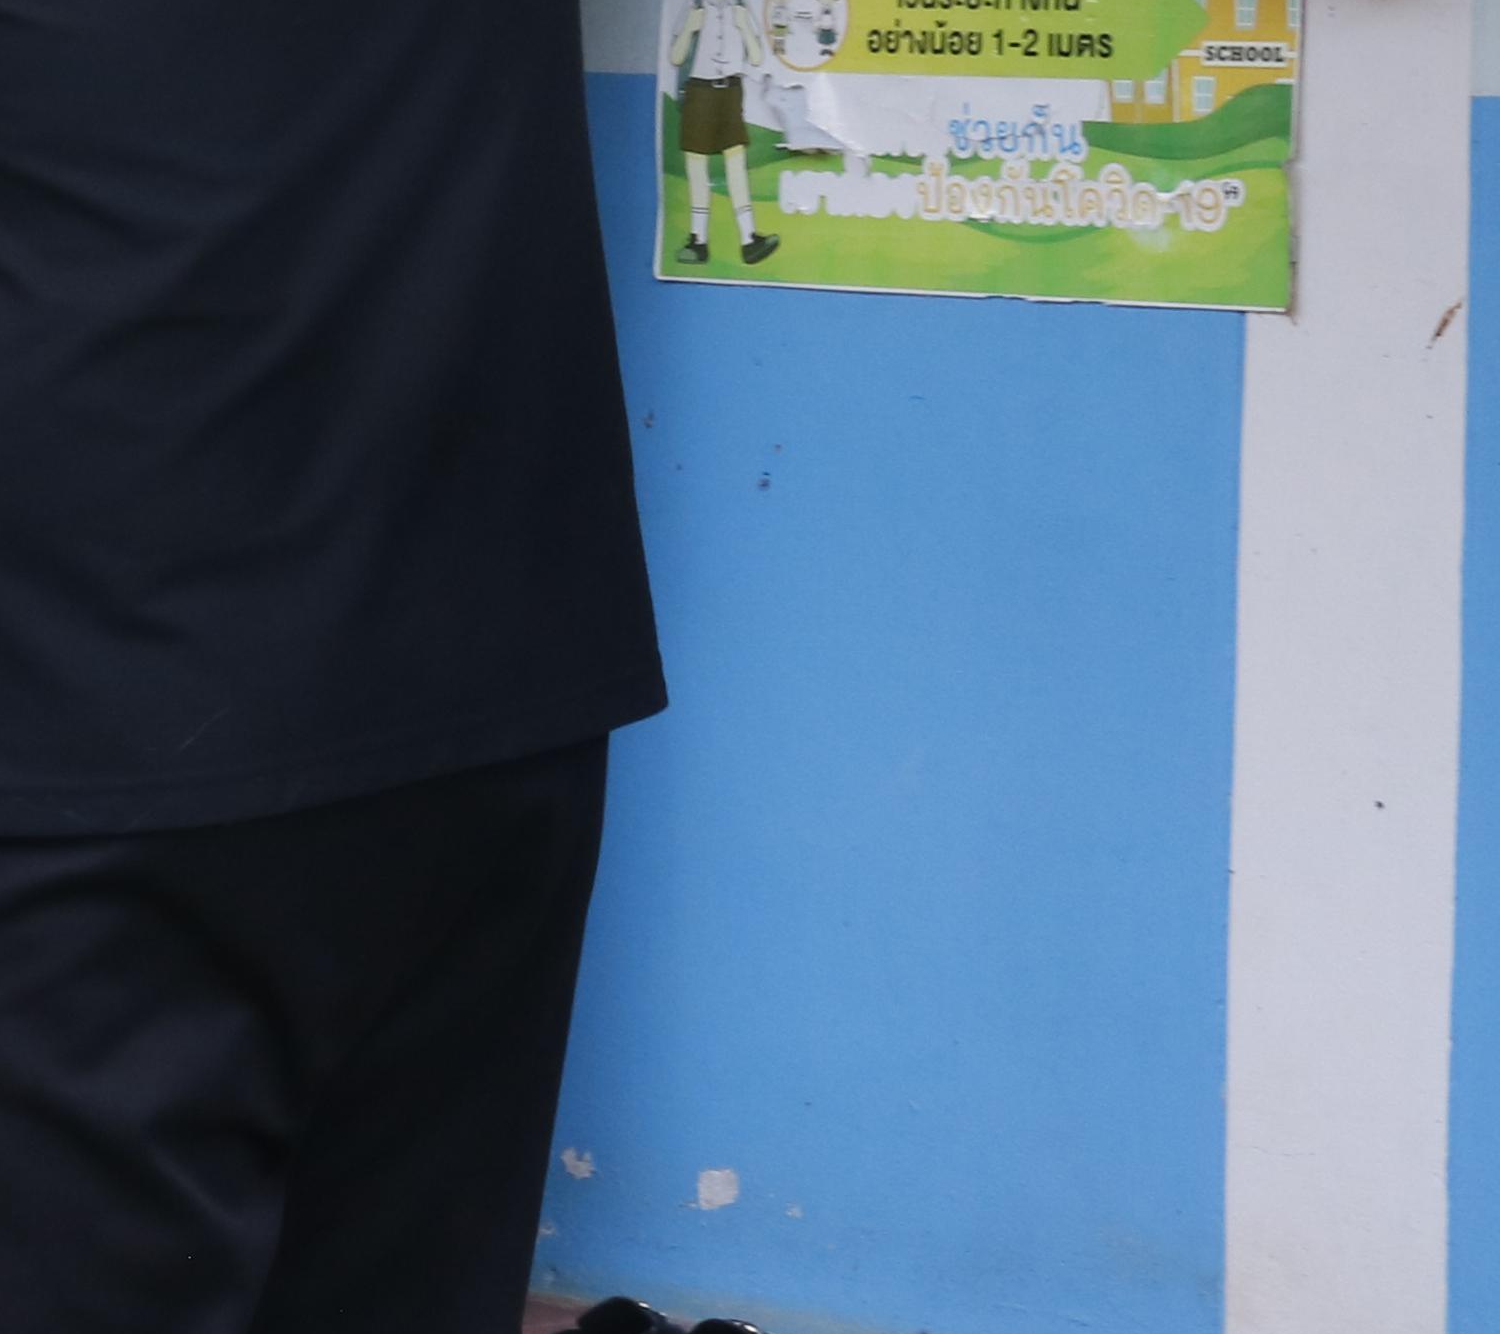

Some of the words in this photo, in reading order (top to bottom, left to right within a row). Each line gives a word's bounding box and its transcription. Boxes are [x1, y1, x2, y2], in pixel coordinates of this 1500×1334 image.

[866, 20, 982, 57] อย่างน้อย
[991, 29, 1039, 57] 1-2
[1048, 31, 1114, 59] เมตร
[1204, 44, 1286, 63] SCHOOL
[949, 104, 1083, 158] ช่วยกัน
